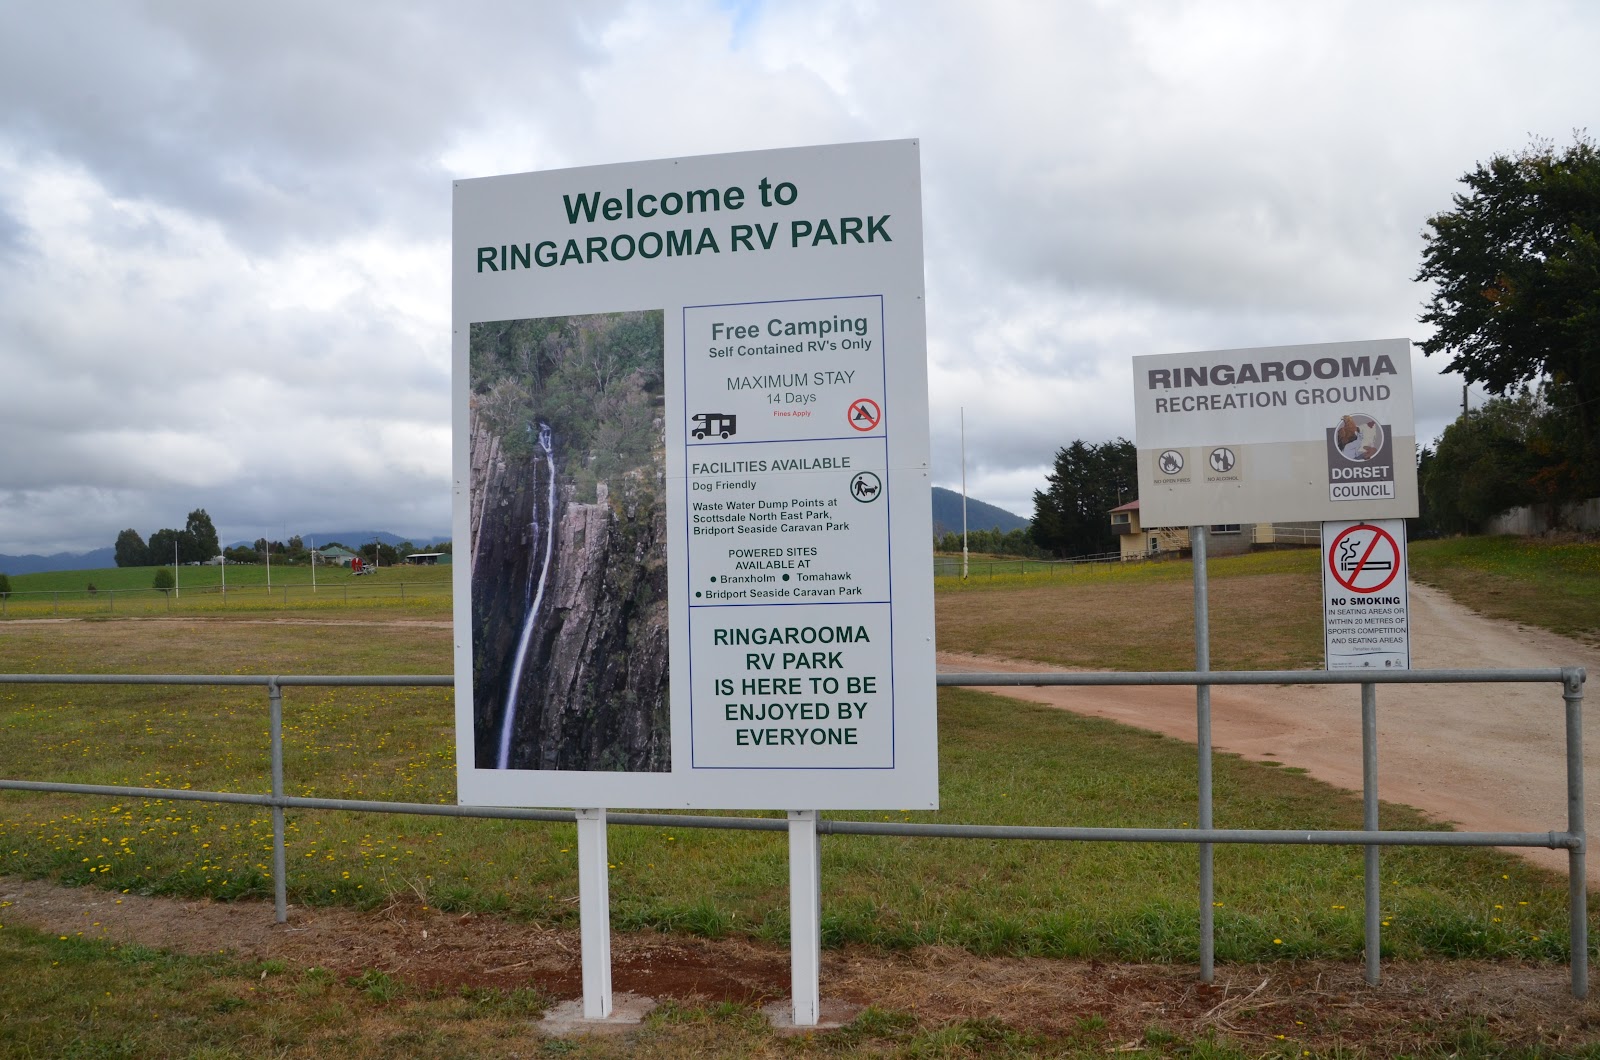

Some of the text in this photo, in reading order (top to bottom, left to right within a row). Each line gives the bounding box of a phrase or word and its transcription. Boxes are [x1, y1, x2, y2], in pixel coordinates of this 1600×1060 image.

[563, 177, 798, 224] Welcome to
[477, 214, 892, 273] RINGAROOMA RV PARK
[712, 316, 868, 340] Free Camping
[709, 338, 872, 358] Self Contained RV's Only
[727, 370, 855, 390] MAXIMUM STAY
[1149, 355, 1397, 389] RINGAROOMA
[767, 392, 817, 405] 14 Days
[1155, 385, 1390, 413] RECREATION GROUND
[692, 457, 850, 474] FACILITIES AVAILABLE
[1332, 466, 1389, 479] DORSET
[693, 480, 756, 492] Dog Friendly
[1333, 485, 1390, 498] COUNCIL
[693, 498, 837, 511] Waste Water Dump Points at
[693, 511, 832, 523] Scottsdale North East Park,
[693, 522, 849, 536] Bridport Seaside Caravan Park
[728, 548, 817, 558] POWERED SITES
[736, 560, 811, 570] AVAILABLE AT
[721, 572, 852, 583] Branxholm Tomahawk
[706, 587, 862, 600] Bridport Seaside Caravan Park
[1350, 597, 1400, 605] SMOKING
[714, 626, 870, 645] RINGAROOMA
[747, 652, 843, 670] RV PARK
[715, 677, 876, 695] IS HERE TO BE
[726, 702, 868, 720] ENJOYED BY
[736, 728, 857, 745] EVERYONE
